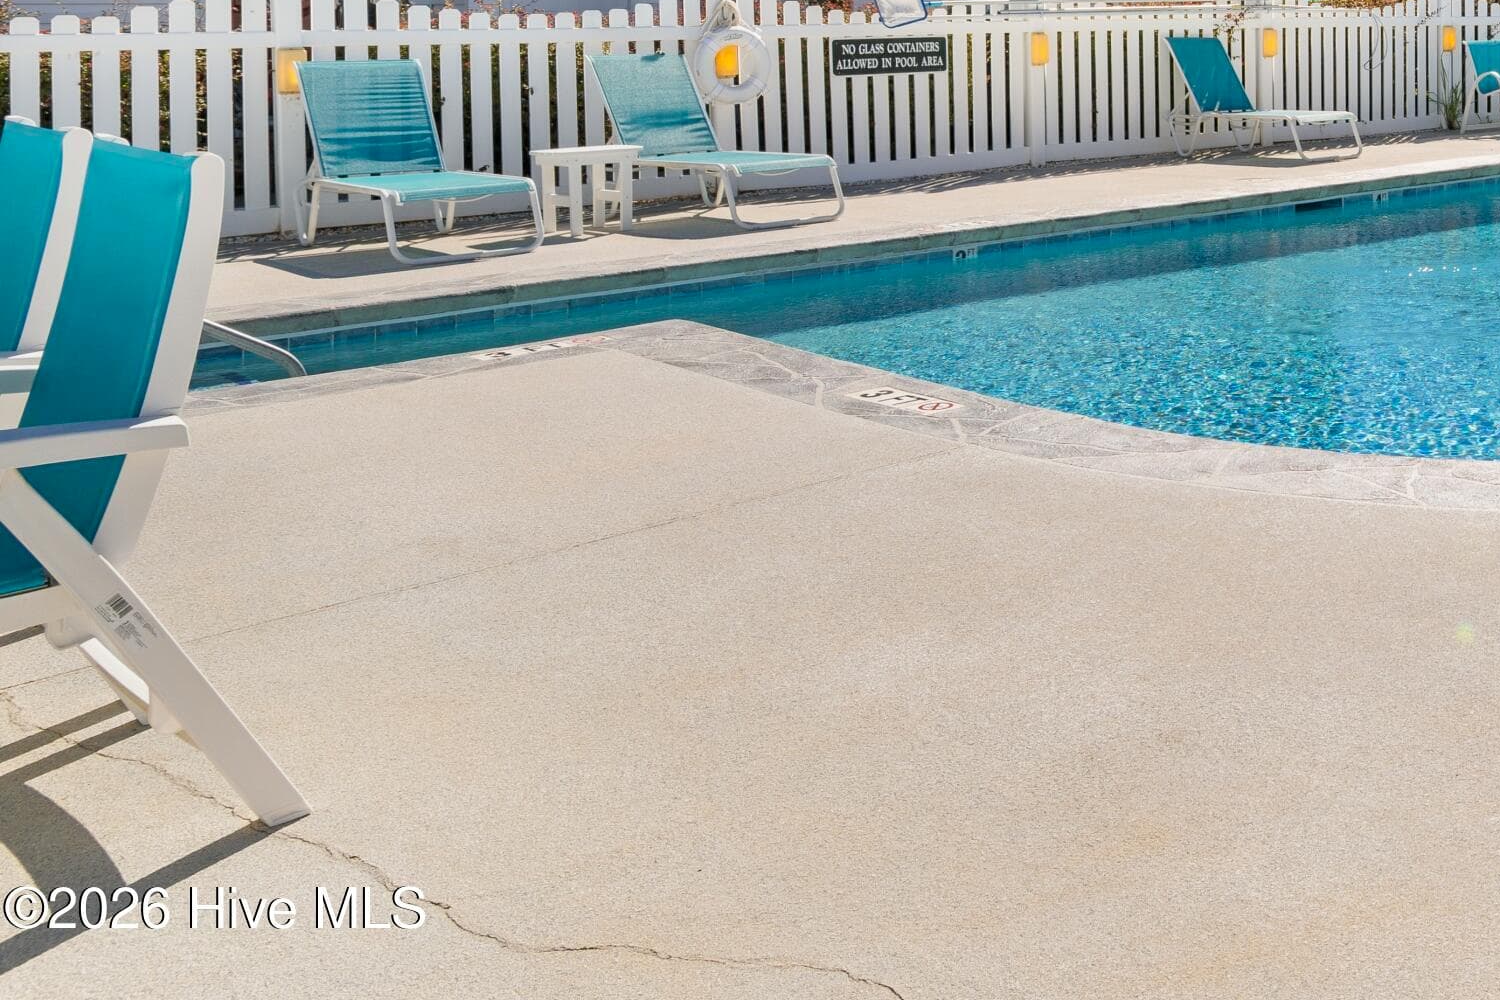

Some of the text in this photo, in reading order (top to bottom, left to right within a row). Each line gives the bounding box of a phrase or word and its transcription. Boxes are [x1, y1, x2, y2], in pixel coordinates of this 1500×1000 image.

[842, 41, 940, 55] NO GLASS CONTAINERS
[836, 55, 944, 70] ALLOWED IN POOL AREA
[860, 389, 929, 406] 3 FT
